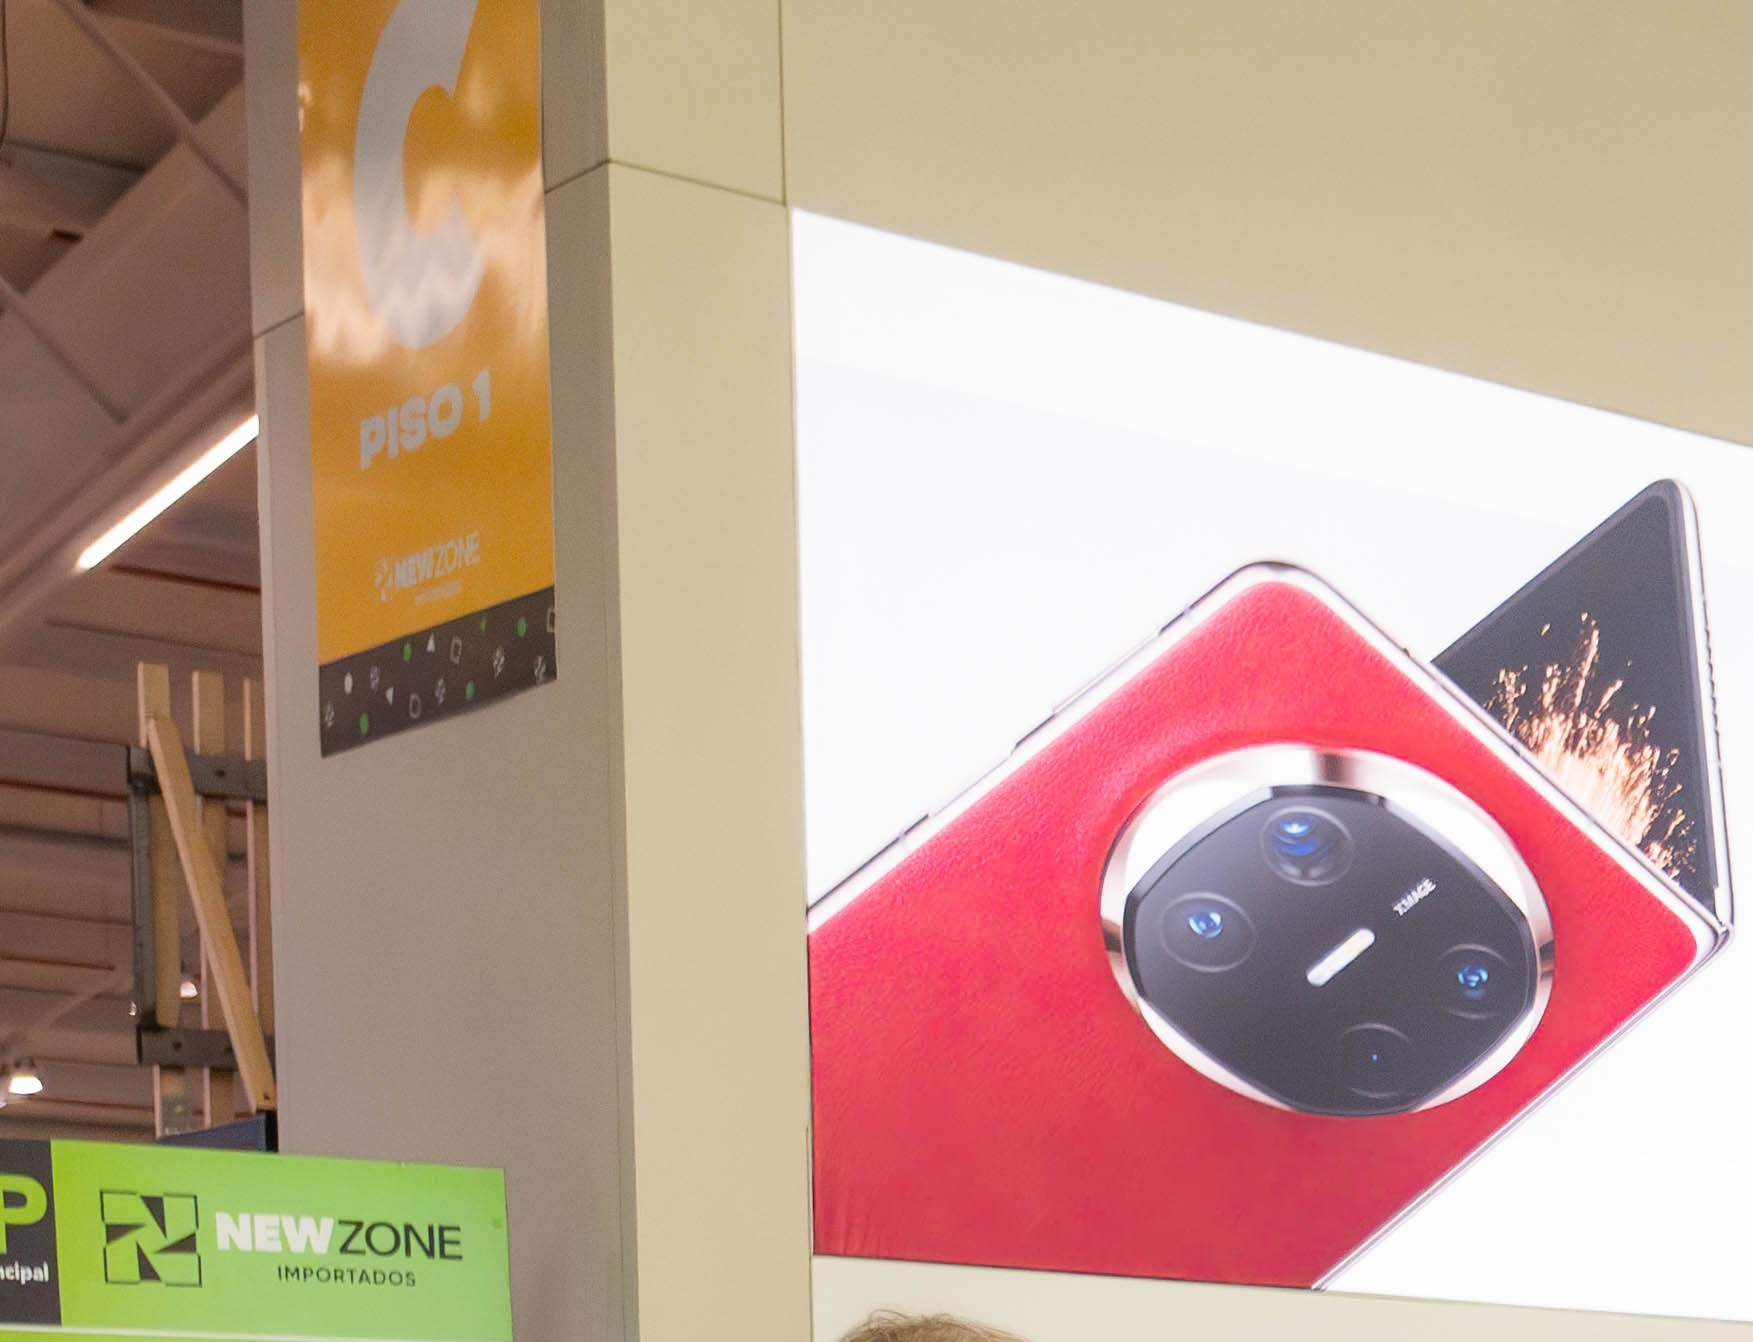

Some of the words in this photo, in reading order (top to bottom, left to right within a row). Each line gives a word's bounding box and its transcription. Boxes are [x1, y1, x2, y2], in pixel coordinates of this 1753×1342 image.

[361, 383, 463, 471] PISO
[472, 367, 491, 422] 1
[216, 1211, 464, 1261] NEWZONE
[277, 1266, 417, 1287] IMPORTADOS
